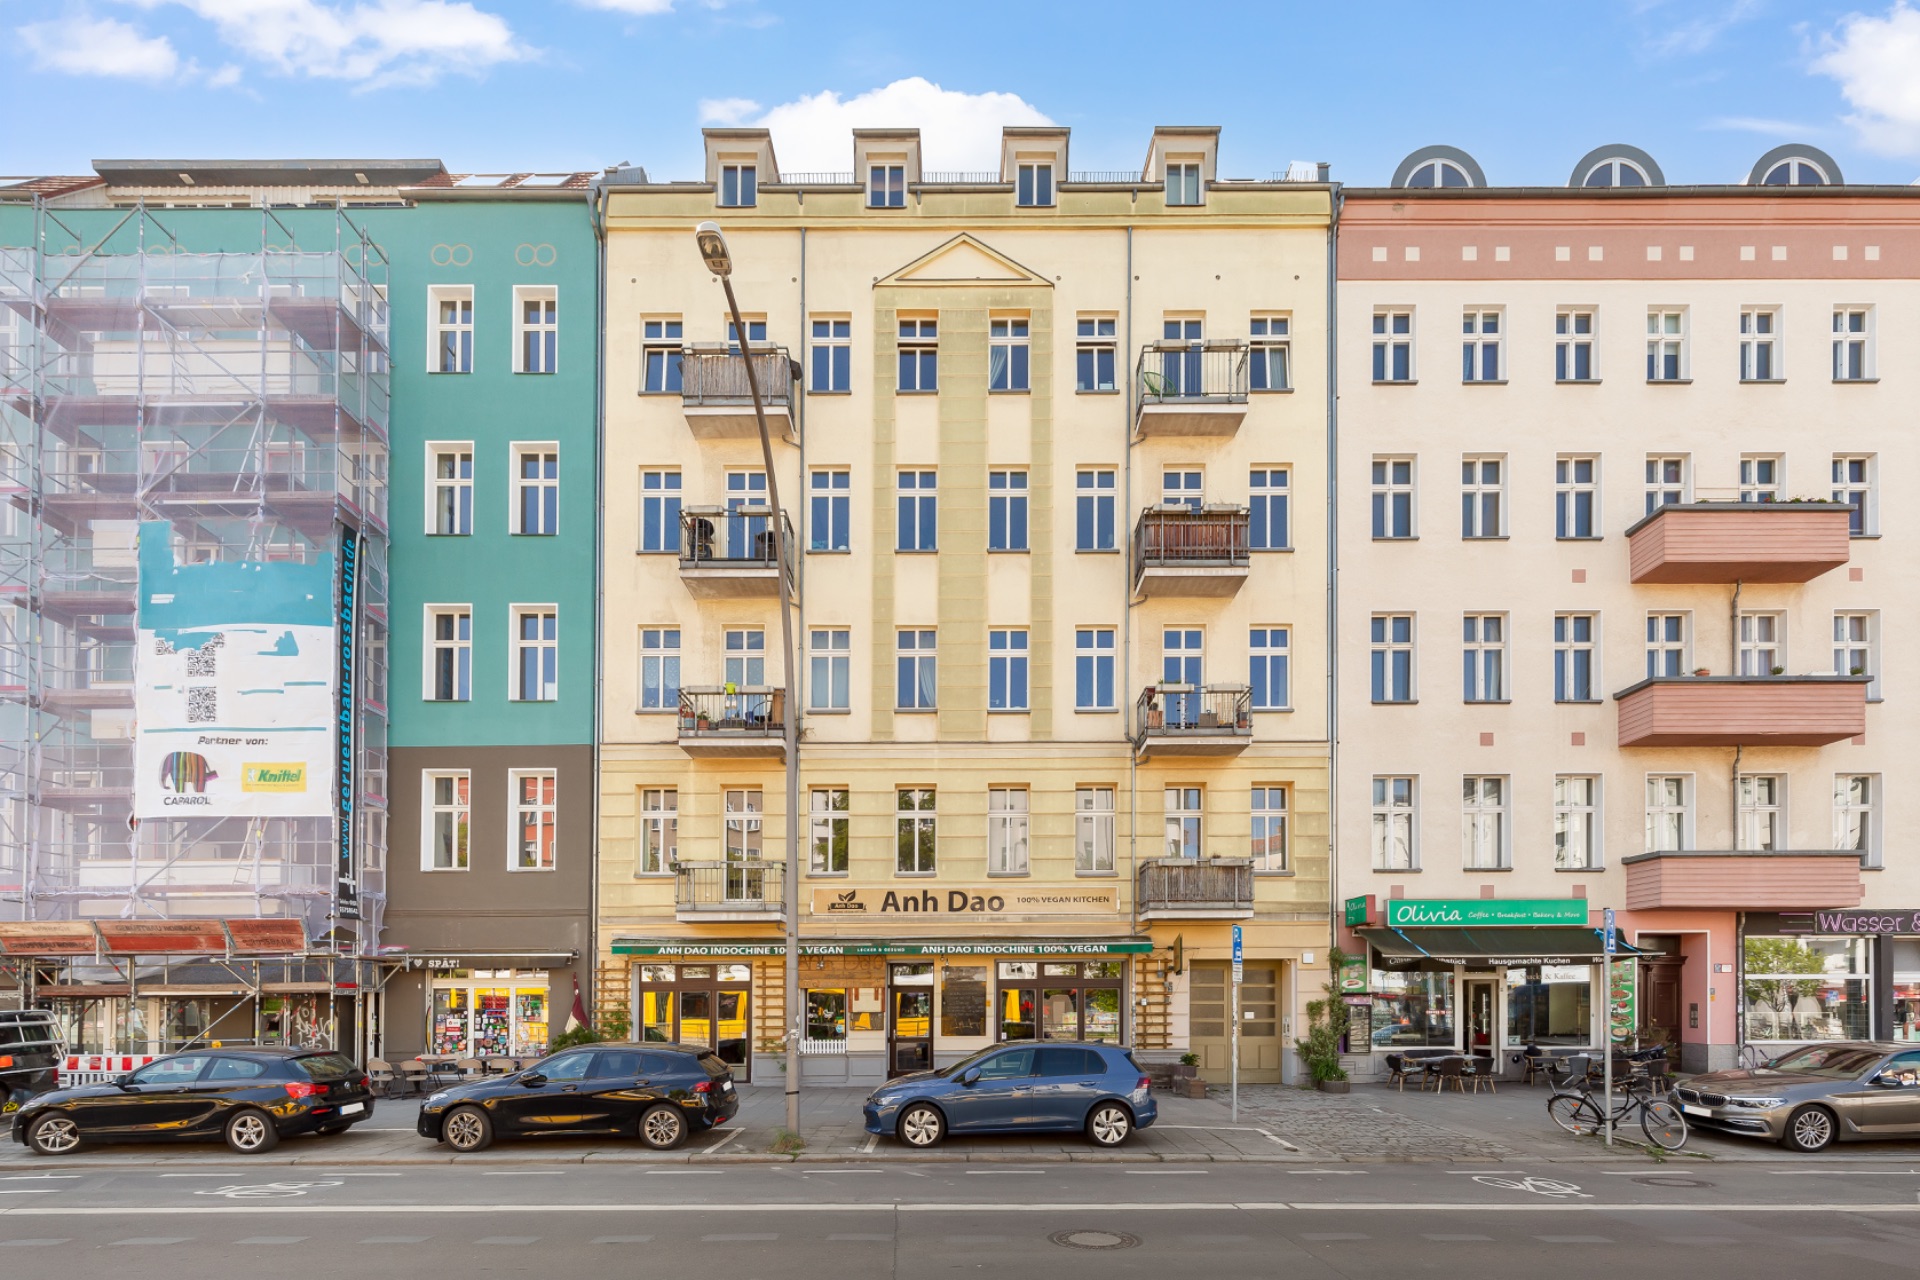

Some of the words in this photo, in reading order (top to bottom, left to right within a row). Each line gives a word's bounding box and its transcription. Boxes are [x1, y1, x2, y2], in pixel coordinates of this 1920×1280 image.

[198, 736, 242, 745] Partner
[246, 737, 268, 745] von:
[163, 796, 213, 806] CAPAROL
[881, 890, 938, 912] Anh
[948, 890, 1005, 912] Dao
[1397, 905, 1463, 922] Olivia
[1468, 911, 1490, 919] Coffee
[1497, 911, 1527, 919] Breakfast
[1533, 911, 1555, 919] Bakery
[1819, 913, 1904, 932] Wasser
[658, 947, 683, 955] ANH
[684, 947, 708, 955] DAO
[710, 947, 770, 955] INDOCHINE
[805, 946, 844, 954] VEGAN
[921, 946, 946, 954] ANH
[947, 946, 971, 954] DAO
[974, 946, 1035, 954] INDOCHINE
[1037, 946, 1067, 954] 100%
[1070, 945, 1107, 953] VEGAN
[428, 957, 460, 968] SPÄT!
[1488, 957, 1542, 966] Hausgemachte
[1543, 957, 1571, 965] Kuchen
[1545, 972, 1551, 980] &
[1554, 971, 1576, 980] Kaffee
